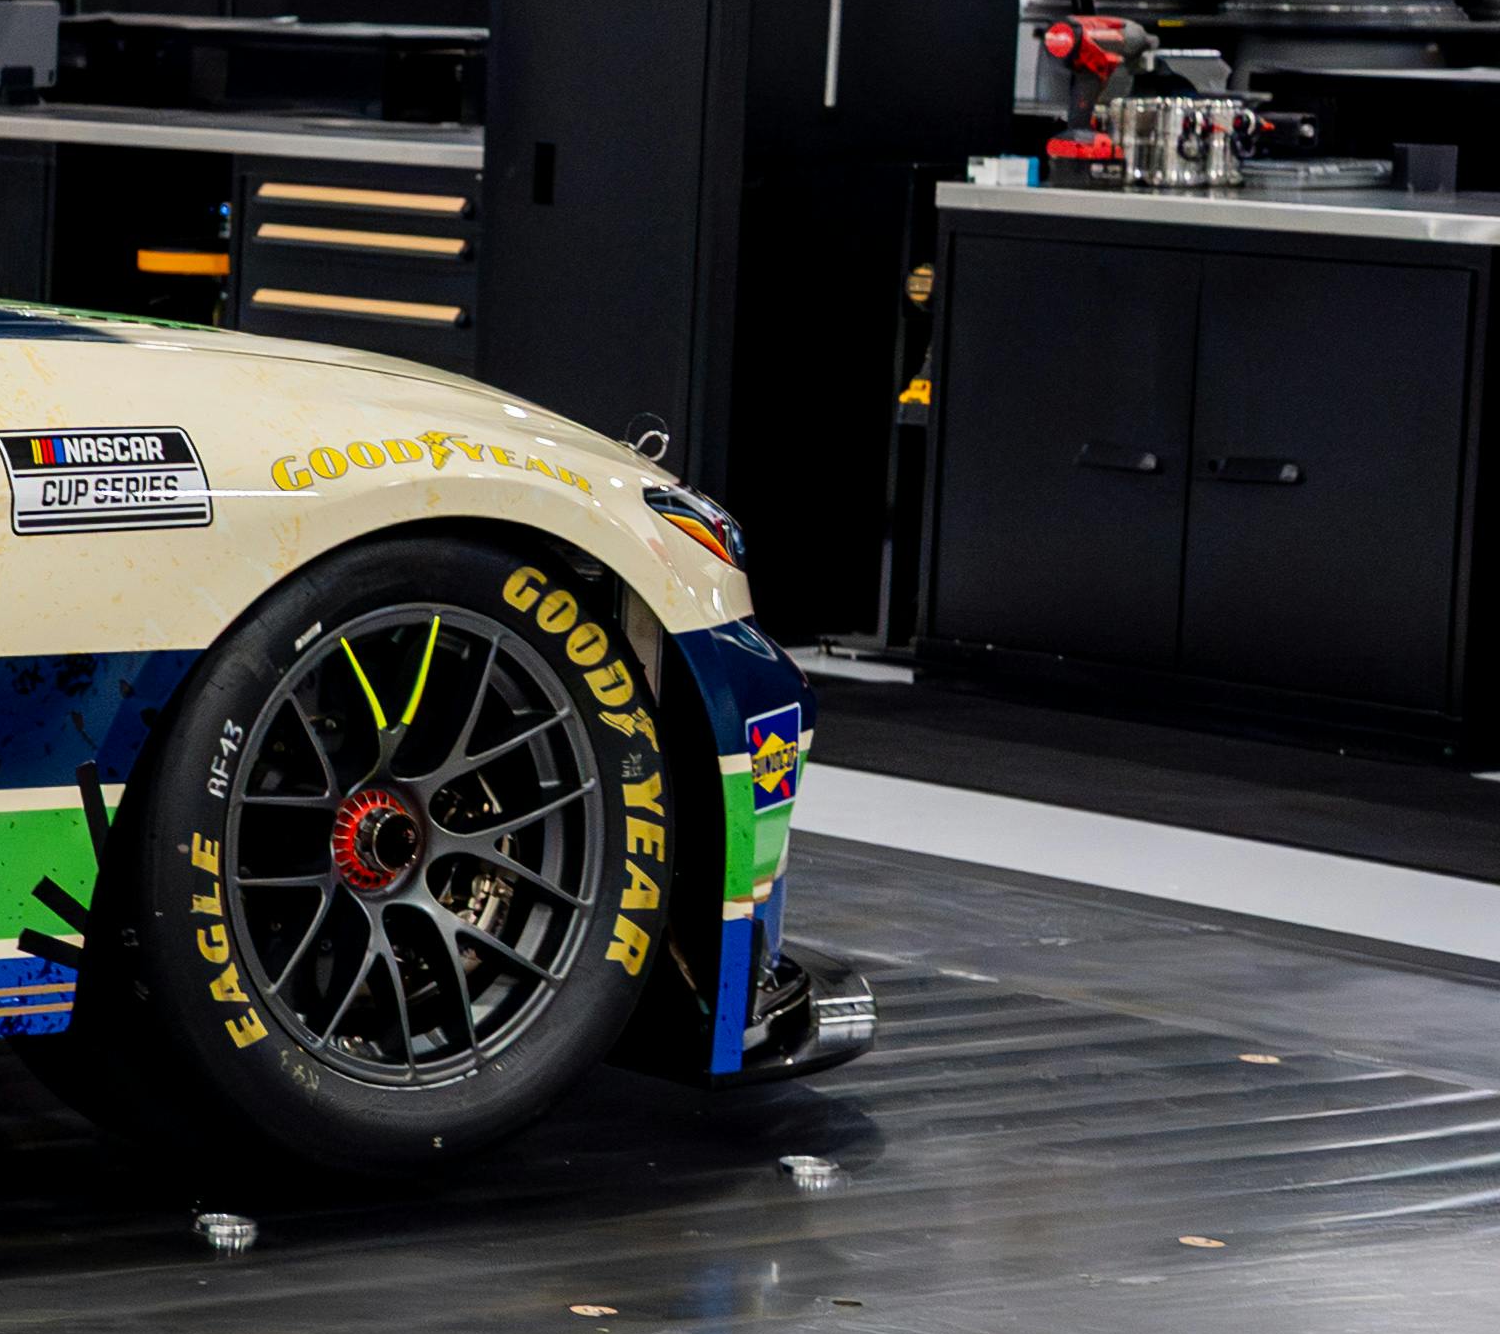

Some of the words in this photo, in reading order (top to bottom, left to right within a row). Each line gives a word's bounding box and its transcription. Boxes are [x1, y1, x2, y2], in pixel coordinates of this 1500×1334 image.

[61, 436, 165, 464] NASCAR
[271, 430, 592, 495] GOODYEAR
[41, 476, 88, 507] CUP
[94, 474, 179, 506] SERIES
[503, 566, 665, 977] GOODYEAR
[191, 832, 269, 1049] EAGLE
